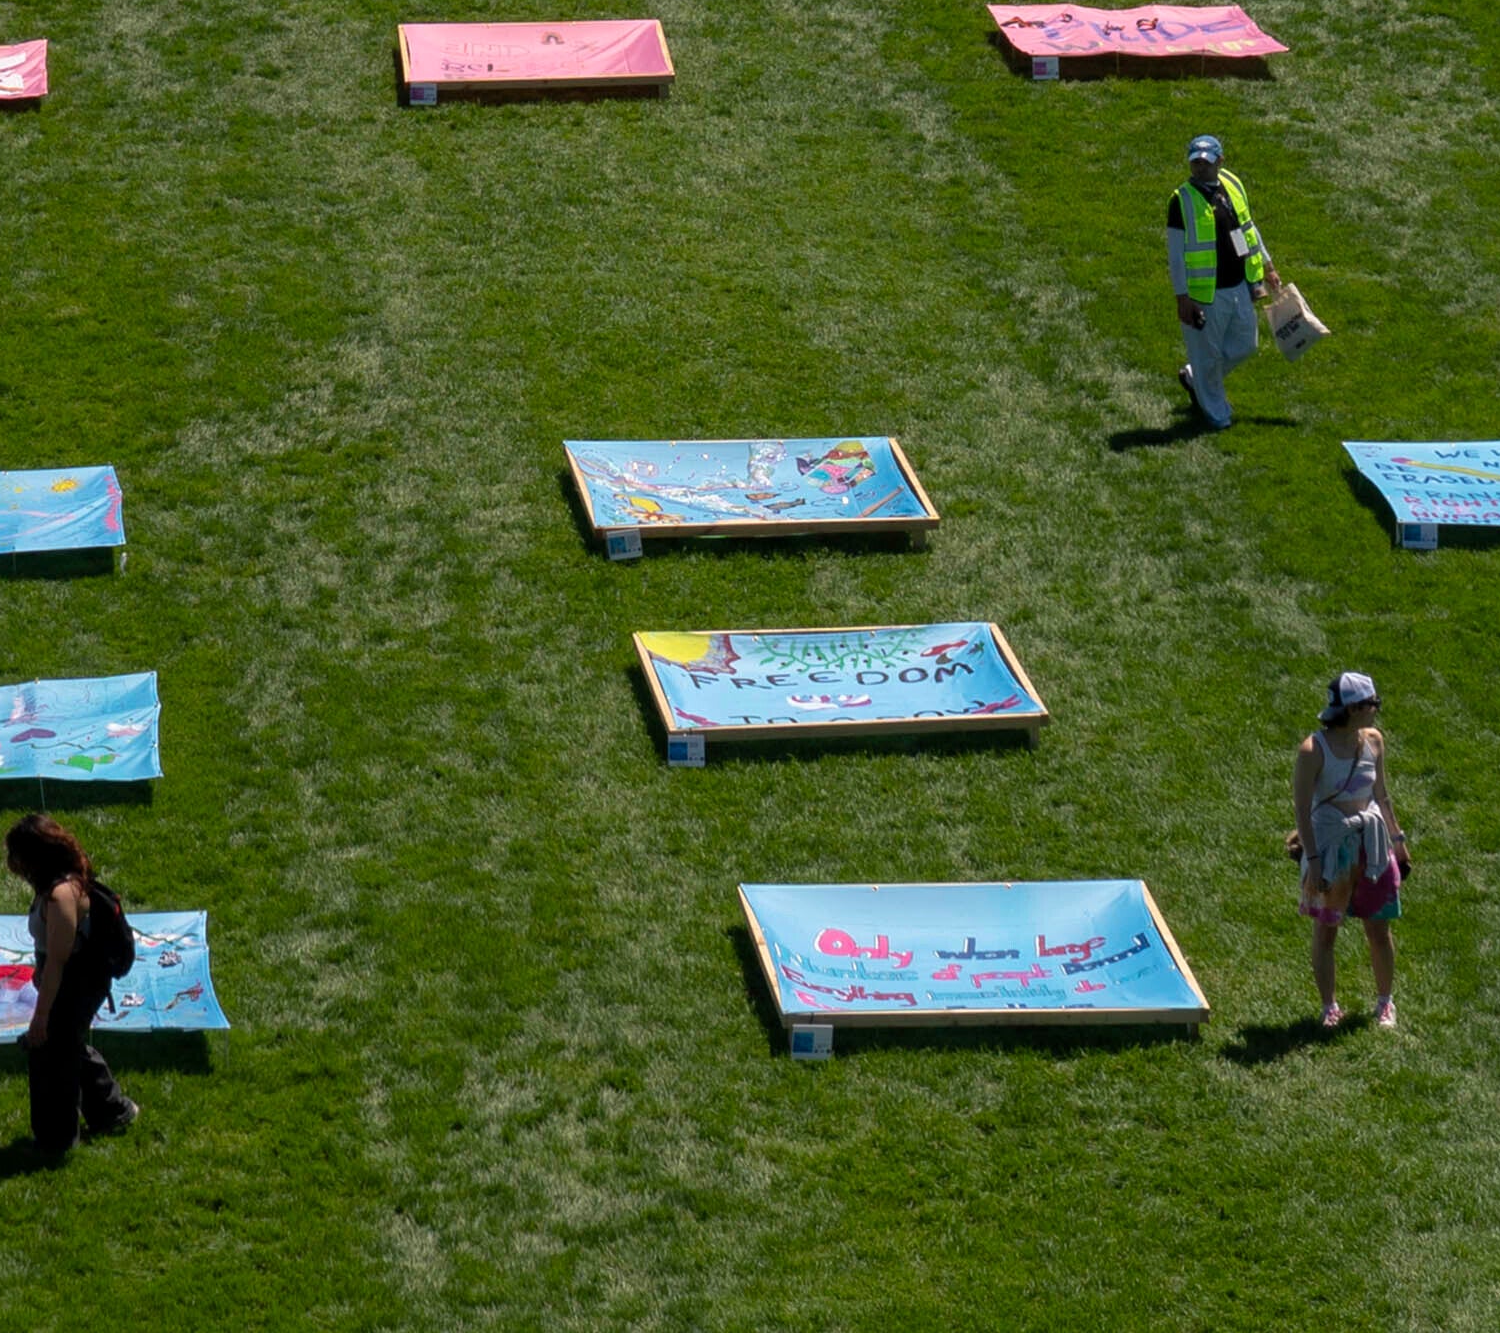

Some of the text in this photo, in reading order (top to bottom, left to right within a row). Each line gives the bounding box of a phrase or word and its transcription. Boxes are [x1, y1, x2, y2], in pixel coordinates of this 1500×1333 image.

[1433, 449, 1480, 458] WE
[1374, 462, 1419, 473] BE
[684, 662, 976, 690] FREEDOM
[814, 928, 914, 970] Only
[935, 937, 1021, 960] when
